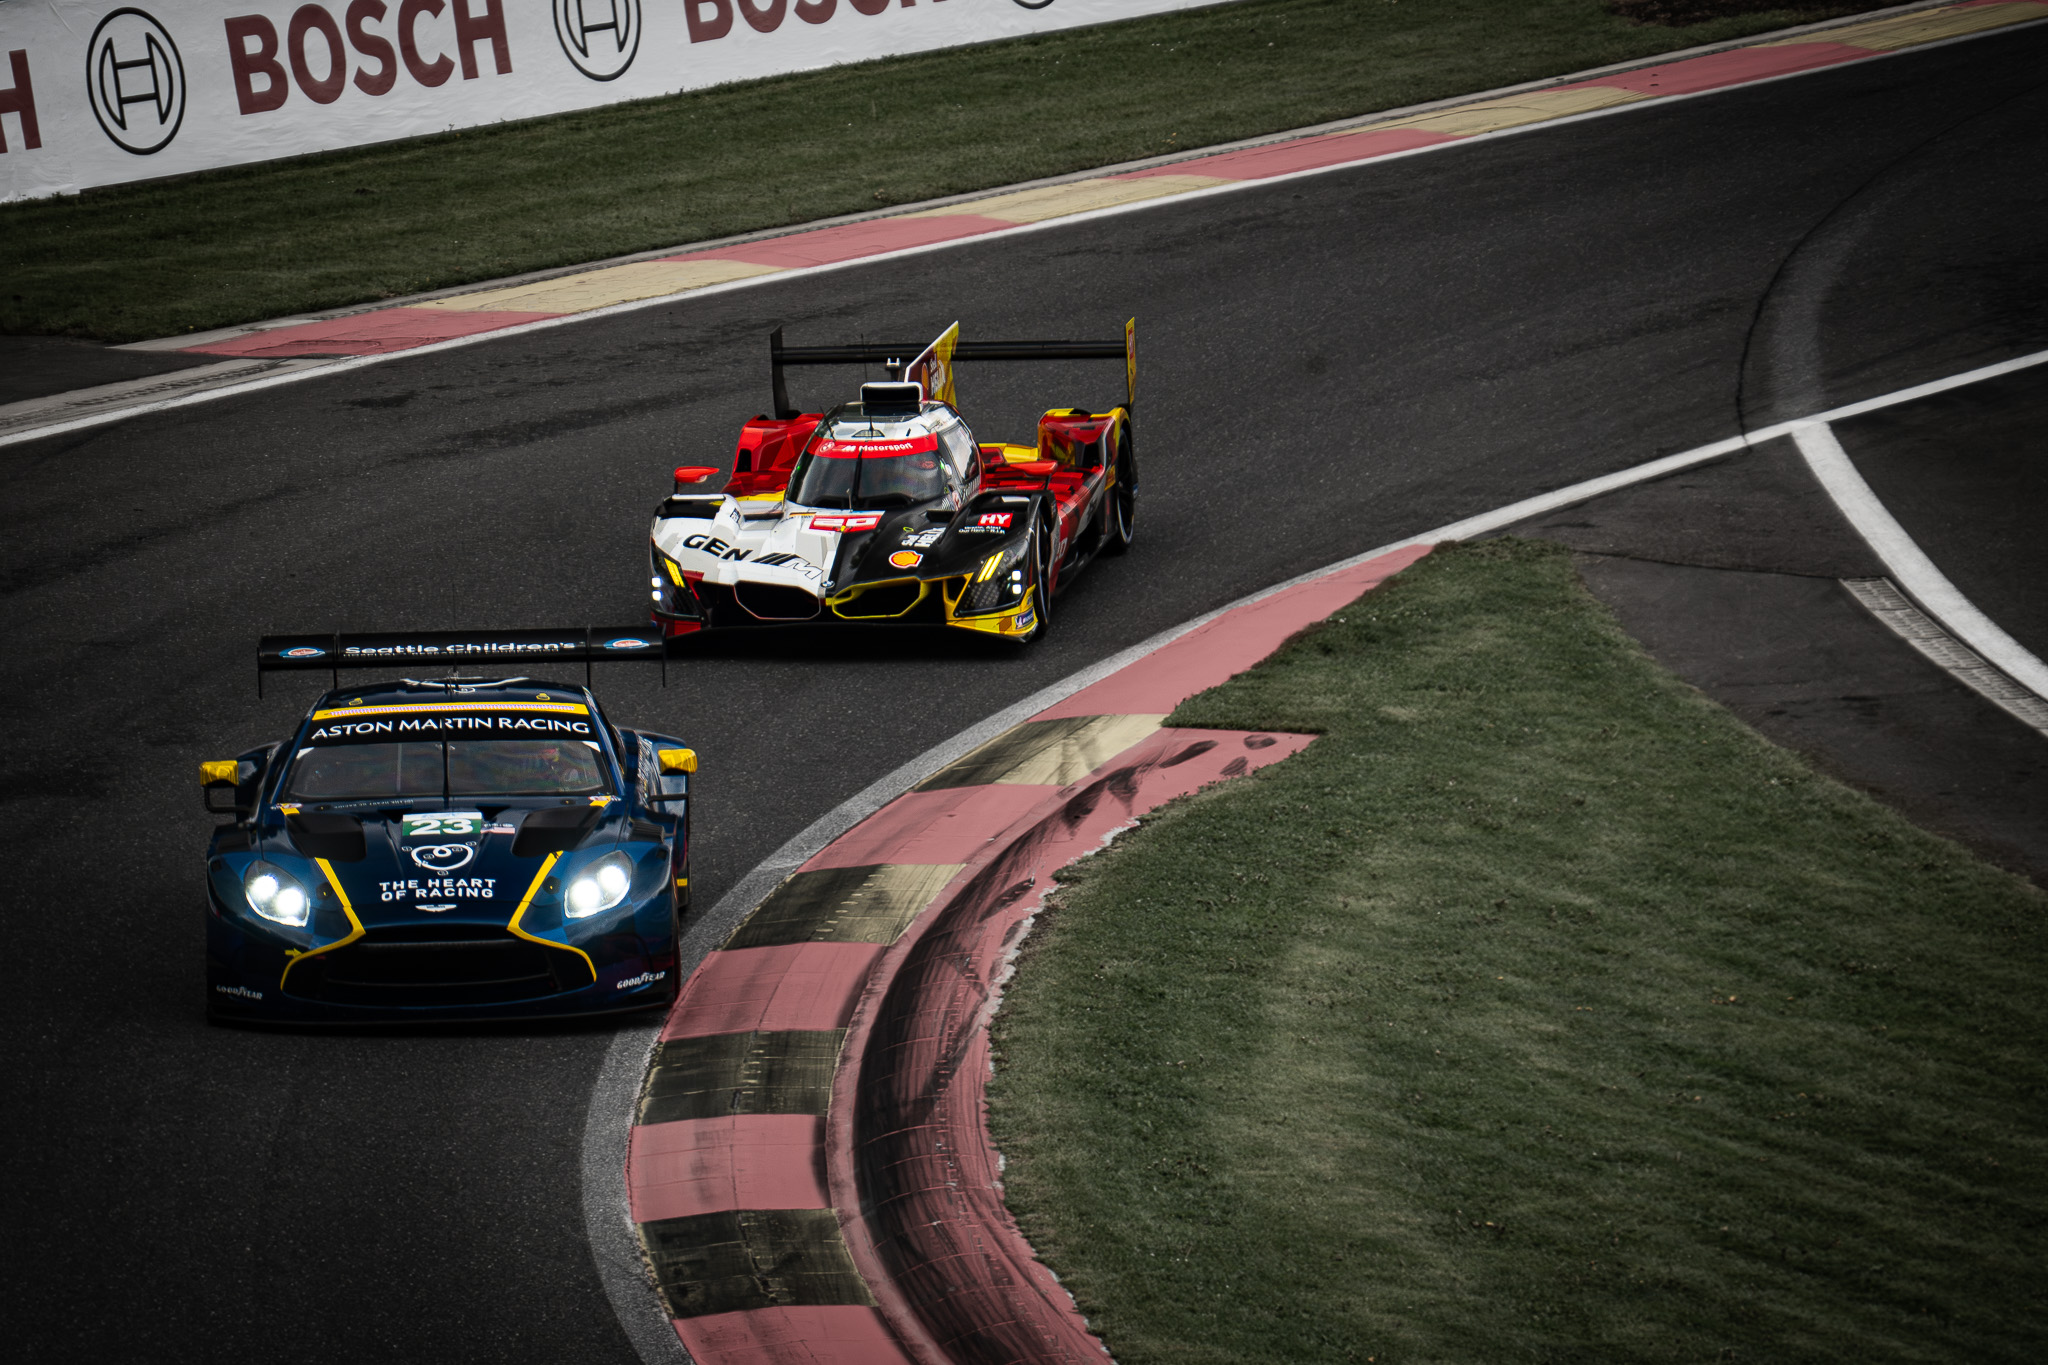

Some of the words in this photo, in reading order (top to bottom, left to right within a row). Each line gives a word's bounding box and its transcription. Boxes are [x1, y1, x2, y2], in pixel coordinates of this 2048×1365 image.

[224, 0, 513, 116] BOSCH
[859, 442, 914, 452] Motorsport
[980, 514, 1011, 525] HY
[683, 533, 754, 561] GEN
[345, 644, 440, 655] Seattle
[446, 642, 576, 653] Children's
[311, 720, 394, 740] ASTON
[399, 717, 493, 731] MARTIN
[498, 718, 591, 734] RACING
[409, 818, 474, 836] 23
[379, 879, 419, 891] THE
[427, 878, 497, 888] HEART
[381, 890, 407, 902] OF
[415, 887, 494, 899] RACING
[616, 971, 666, 989] GOODYEAR
